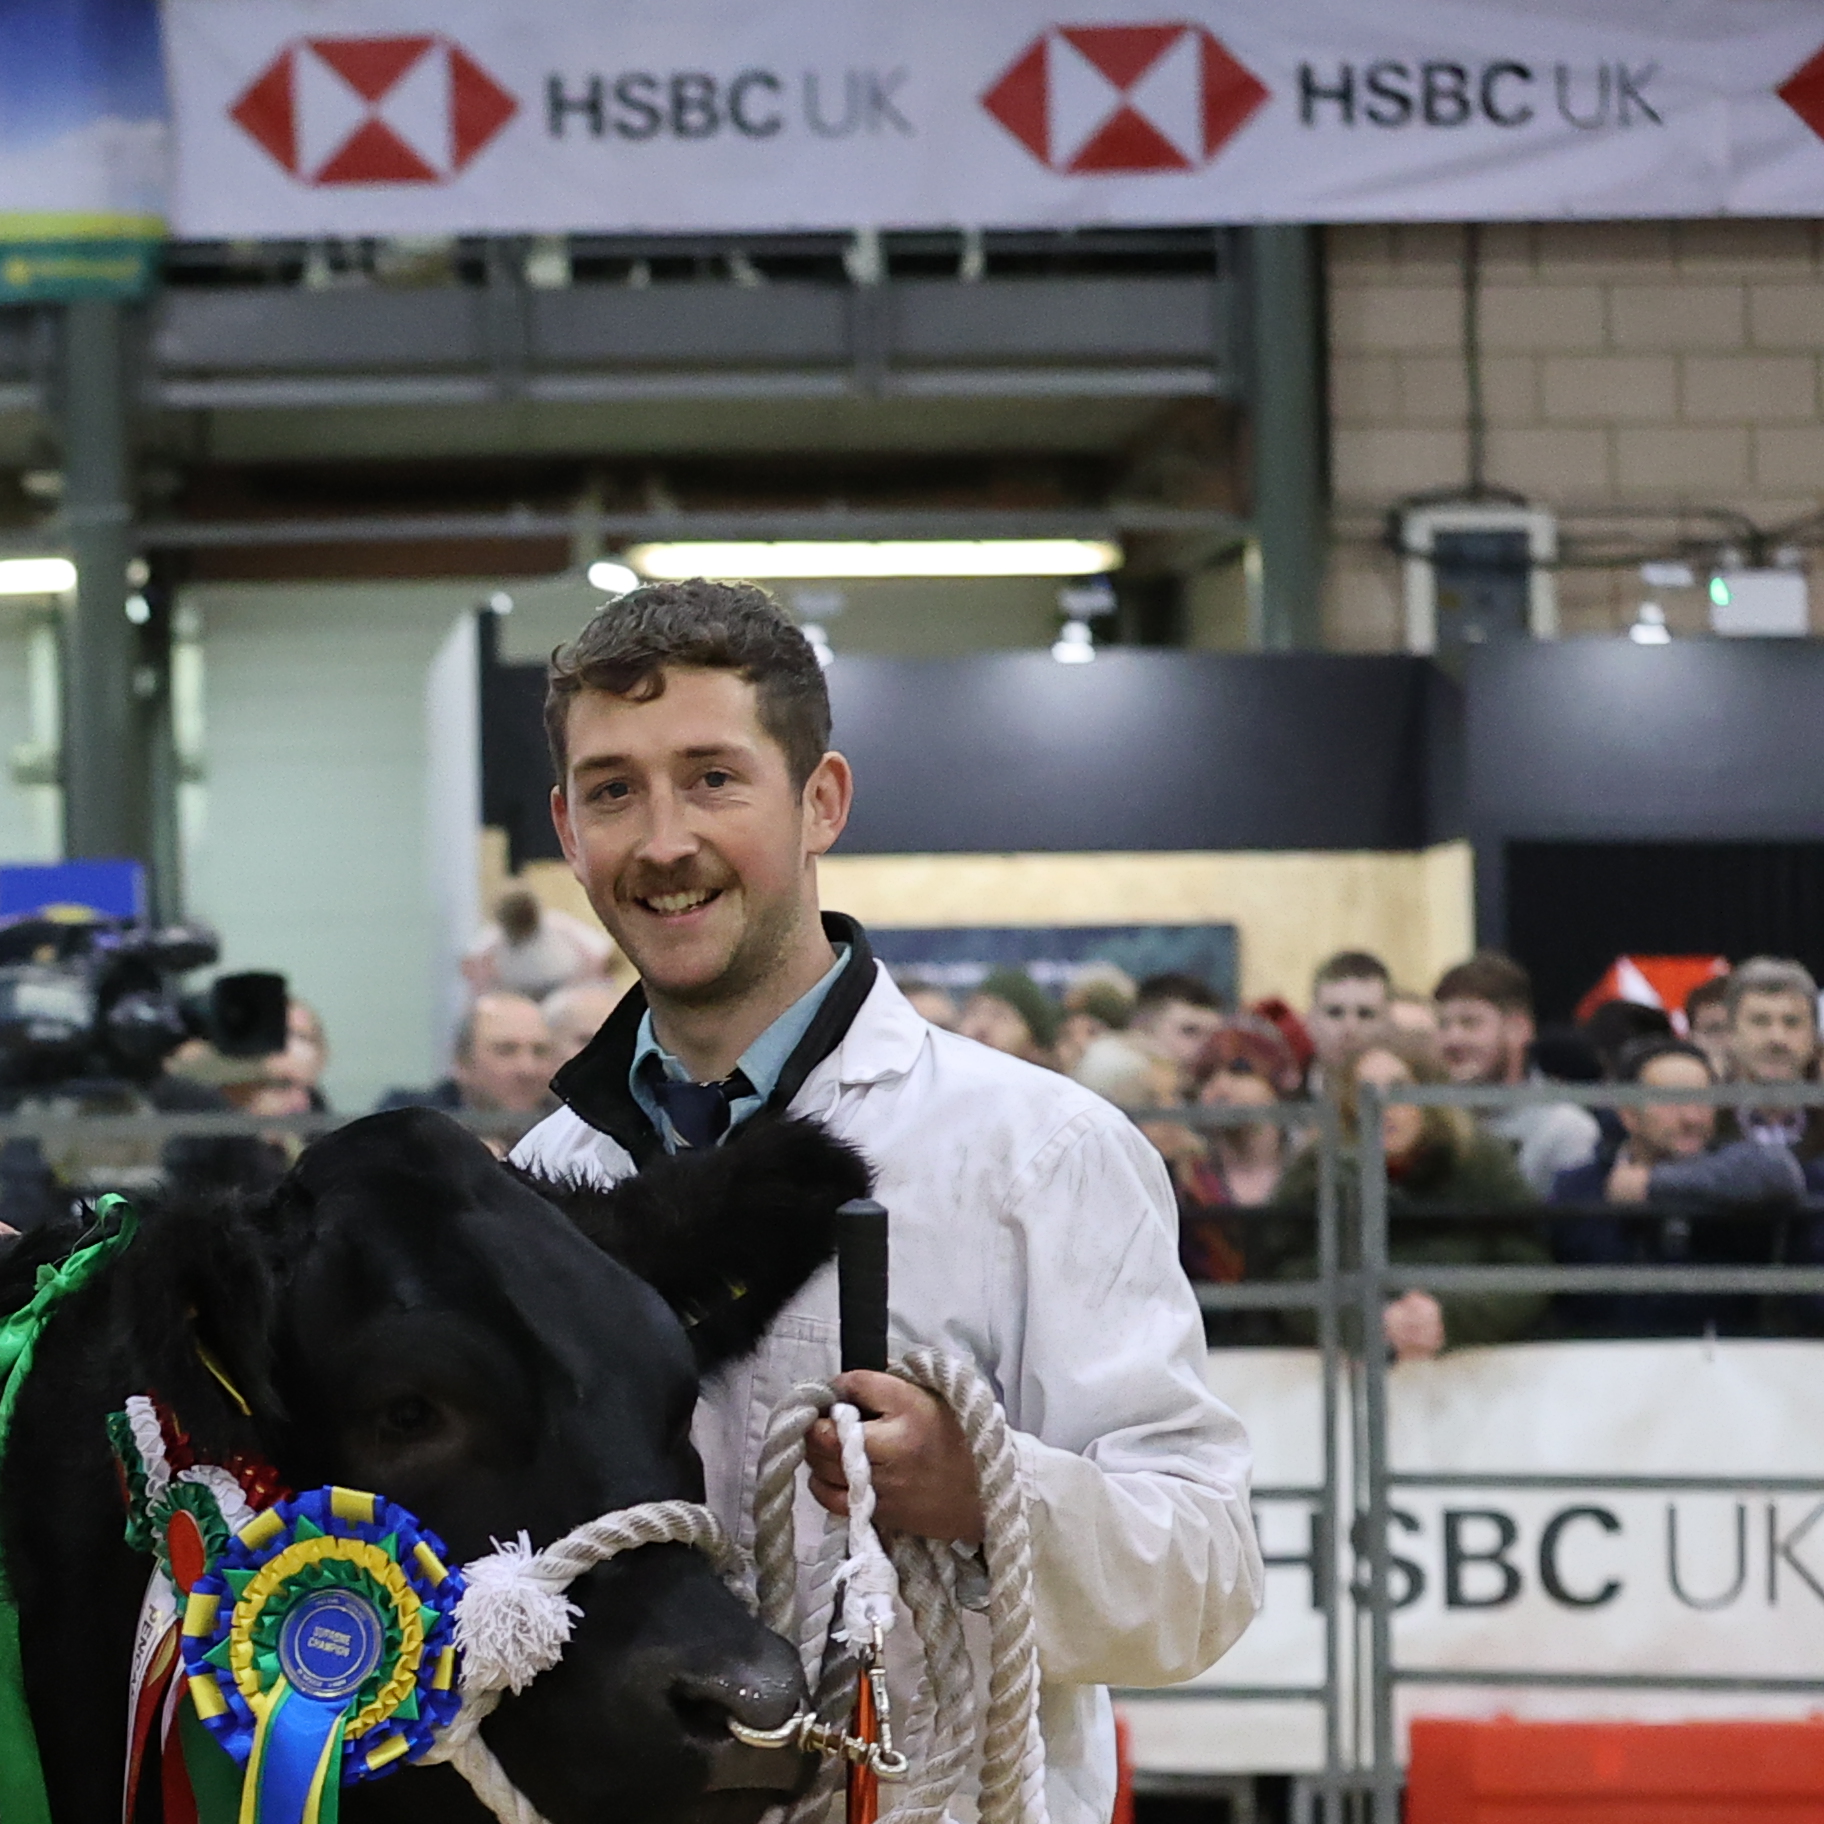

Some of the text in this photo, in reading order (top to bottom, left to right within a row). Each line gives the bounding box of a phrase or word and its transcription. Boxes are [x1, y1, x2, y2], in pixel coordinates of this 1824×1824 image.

[547, 66, 914, 140] HSBC UK
[1298, 59, 1664, 130] HSBC UK
[1666, 1502, 1824, 1611] UK
